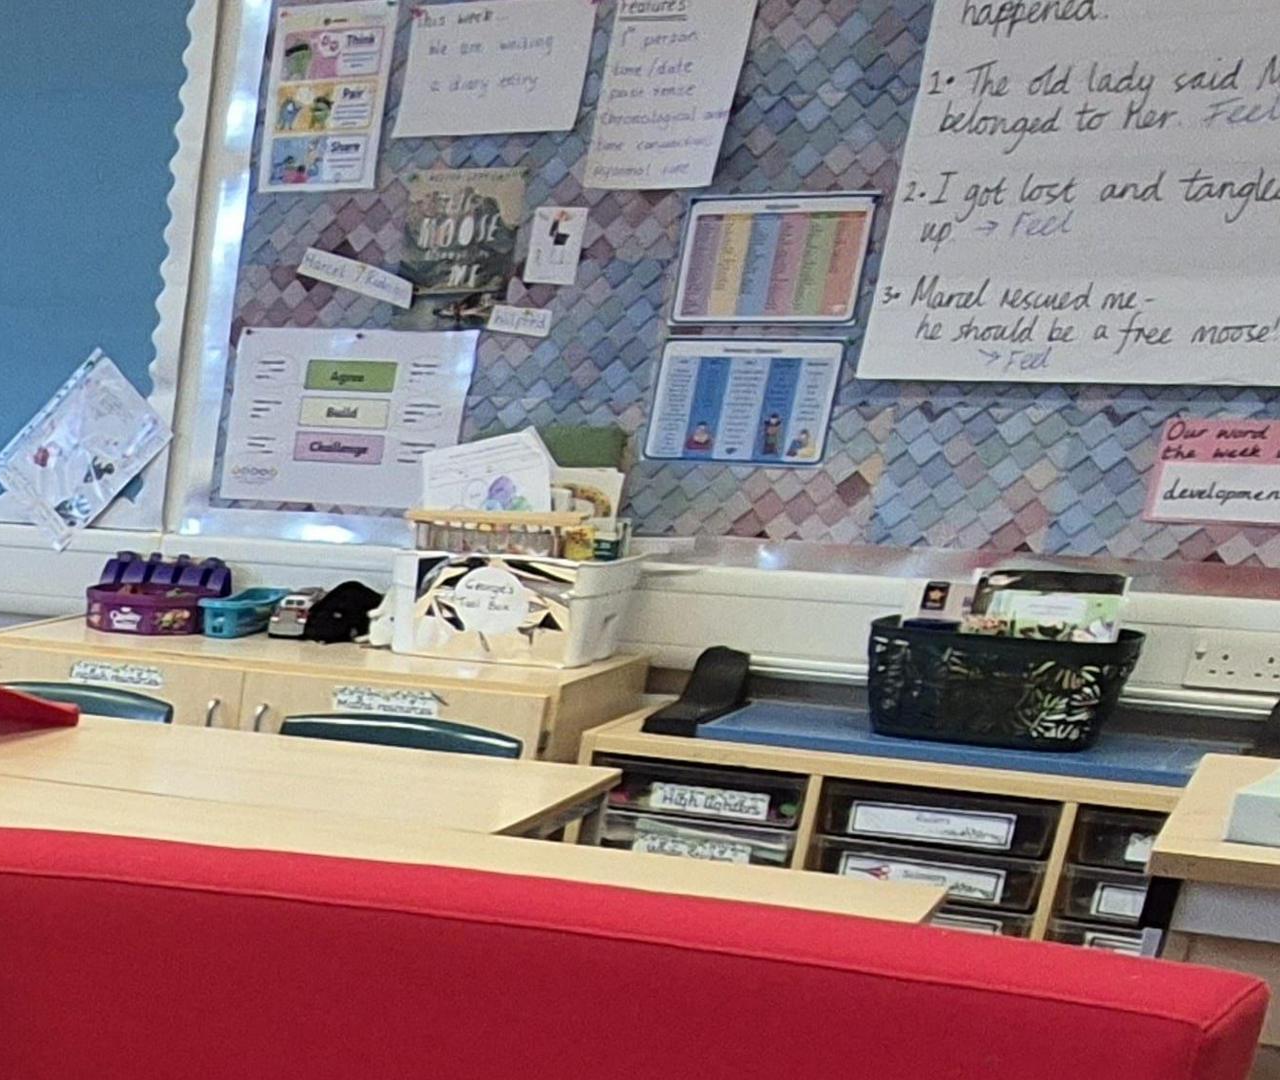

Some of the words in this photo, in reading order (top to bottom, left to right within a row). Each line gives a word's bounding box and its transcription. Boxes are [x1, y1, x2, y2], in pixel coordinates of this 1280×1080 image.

[346, 33, 376, 47] Think
[964, 60, 1009, 97] The
[1028, 65, 1073, 96] old
[1087, 61, 1156, 101] lady
[1173, 58, 1245, 92] said
[342, 87, 365, 100] Pair
[939, 101, 1063, 155] belonged
[1074, 102, 1114, 131] to
[330, 140, 362, 152] Share
[928, 171, 959, 204] I
[954, 176, 1007, 223] got
[1019, 172, 1077, 204] lost
[1099, 170, 1167, 201] and
[1010, 210, 1074, 237] Feel
[999, 282, 1095, 311] rescued
[915, 313, 942, 342] he
[951, 315, 1038, 344] should
[1046, 318, 1075, 345] be
[1093, 323, 1109, 341] a
[1115, 311, 1174, 355] free
[1004, 347, 1053, 371] Feel
[329, 371, 366, 385] Agree
[325, 406, 359, 420] Build
[1167, 420, 1209, 441] Our
[1216, 424, 1271, 440] word
[309, 441, 370, 458] Challenge
[1161, 444, 1197, 461] the
[1212, 444, 1261, 459] week
